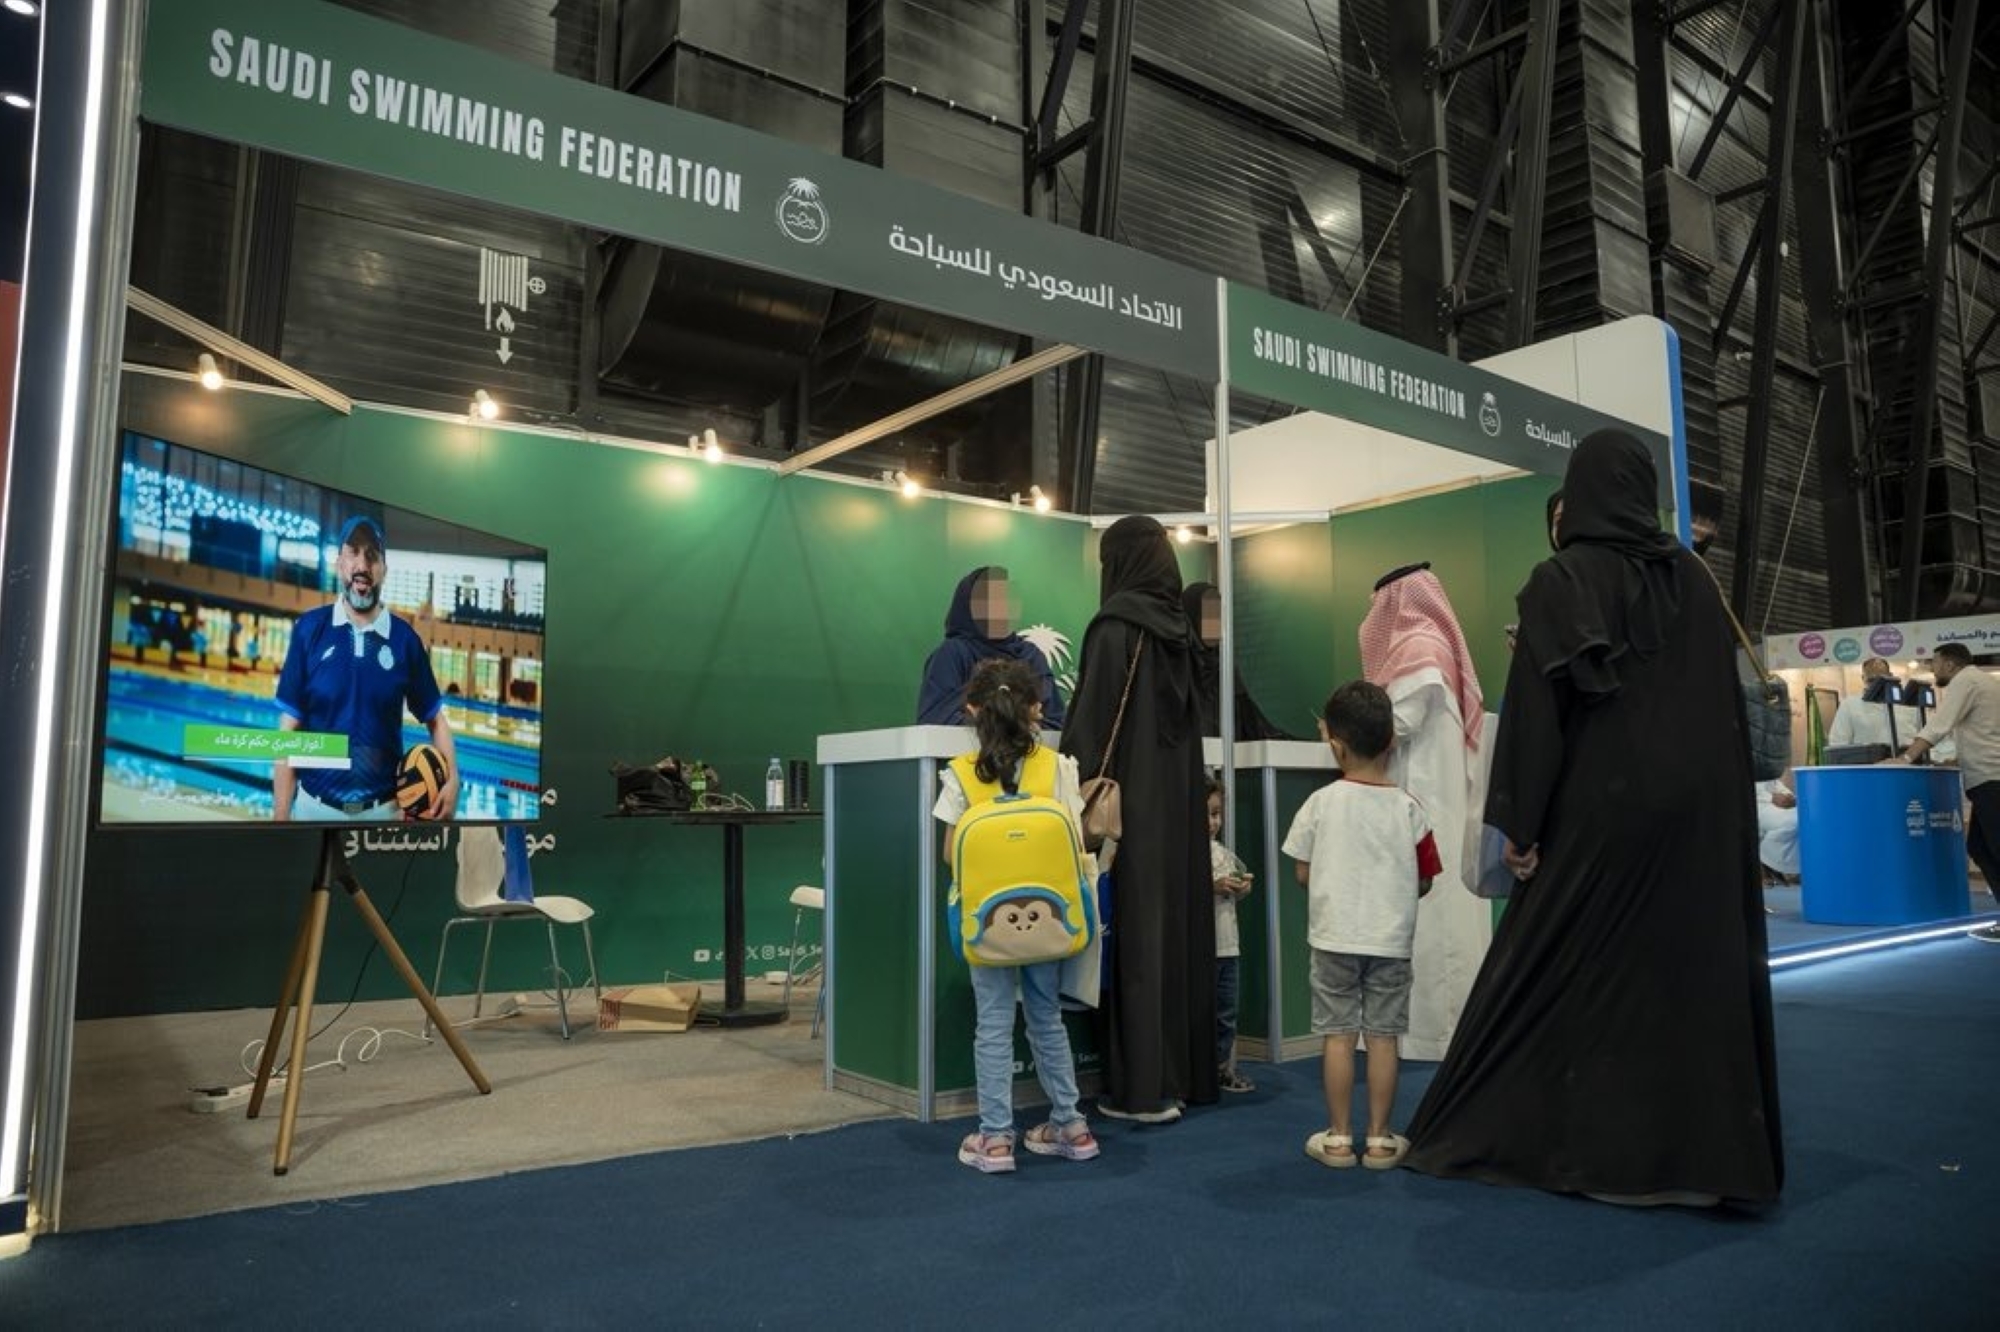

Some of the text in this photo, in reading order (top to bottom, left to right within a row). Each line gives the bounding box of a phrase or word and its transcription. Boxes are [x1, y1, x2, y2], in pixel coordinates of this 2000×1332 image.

[209, 27, 742, 212] SAUDI SWIMMING FEDERATION
[889, 224, 1182, 331] الاتحاد السعودي للسباحة
[1253, 326, 1466, 420] SAUDI SWIMMING FEDERATION
[1525, 418, 1572, 449] للسباحة
